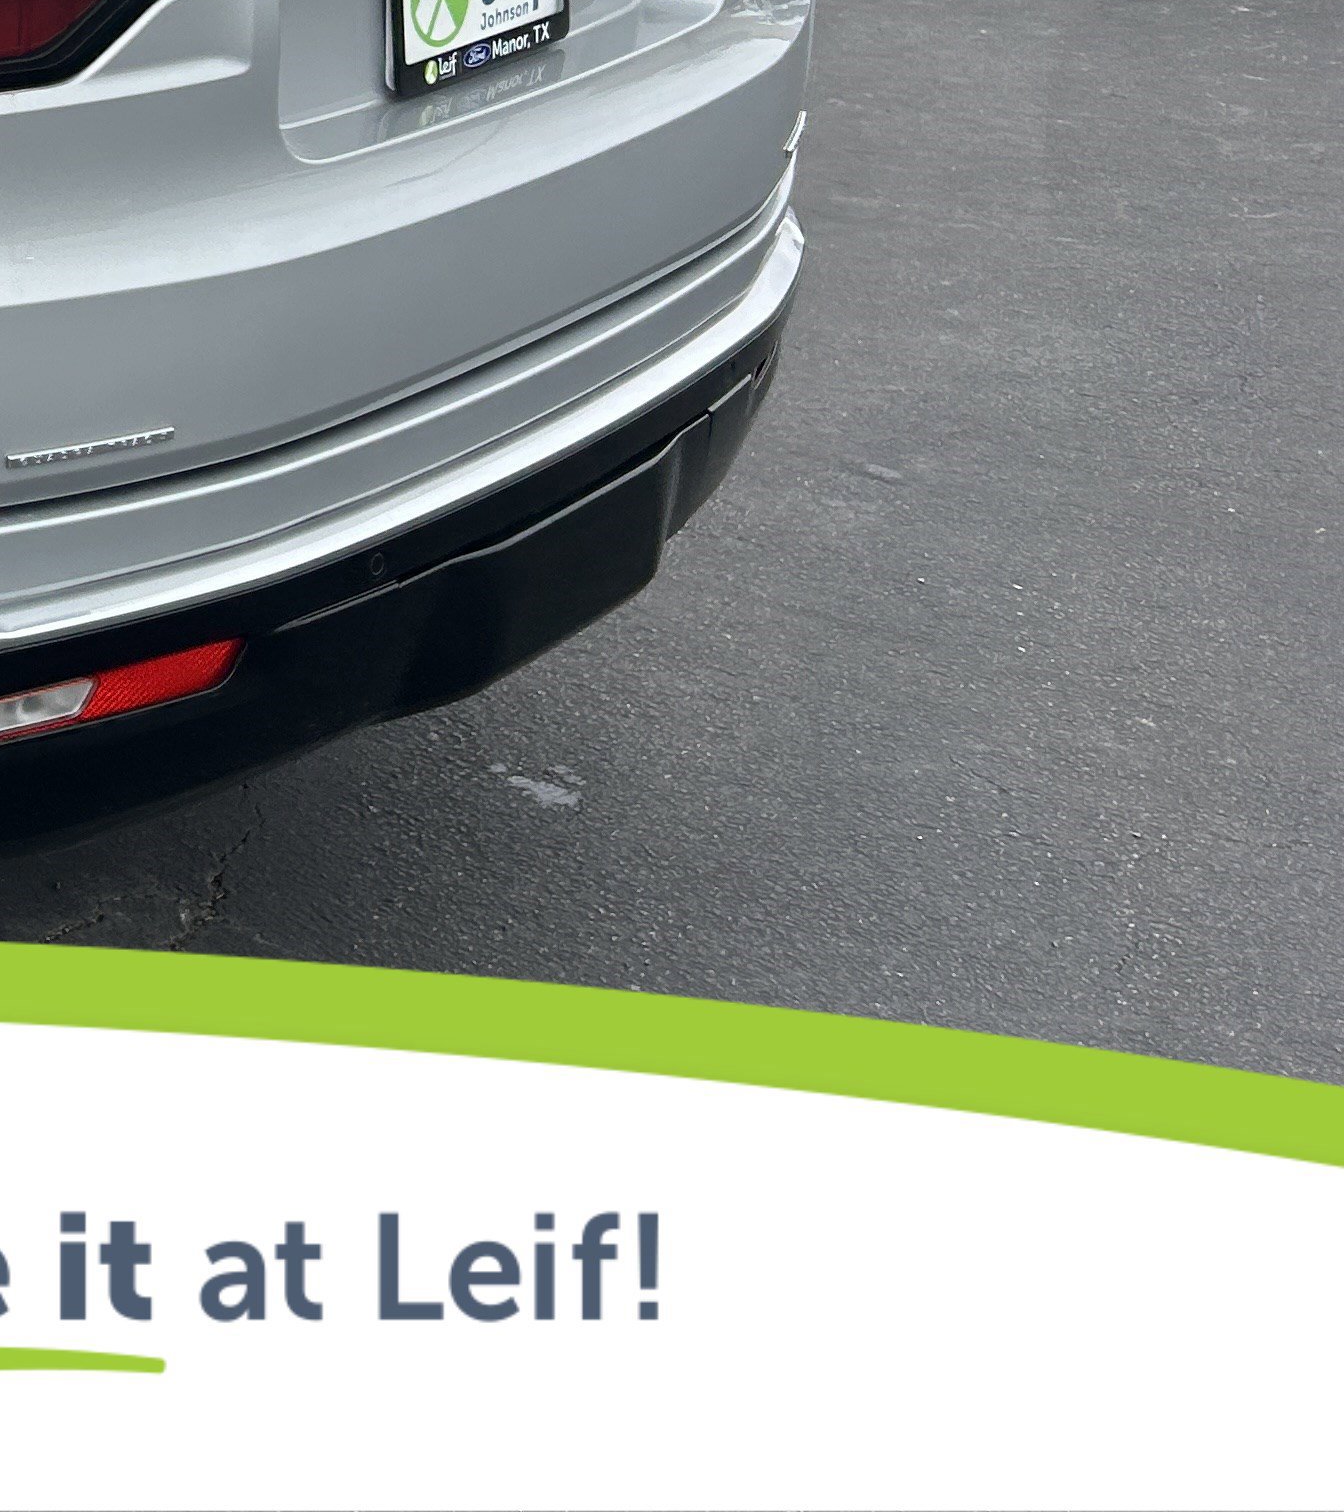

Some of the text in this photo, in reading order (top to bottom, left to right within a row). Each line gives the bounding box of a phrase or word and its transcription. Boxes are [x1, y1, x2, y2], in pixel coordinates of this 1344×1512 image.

[480, 1, 529, 31] Johnson
[492, 33, 531, 60] Manor,
[533, 21, 550, 44] TX
